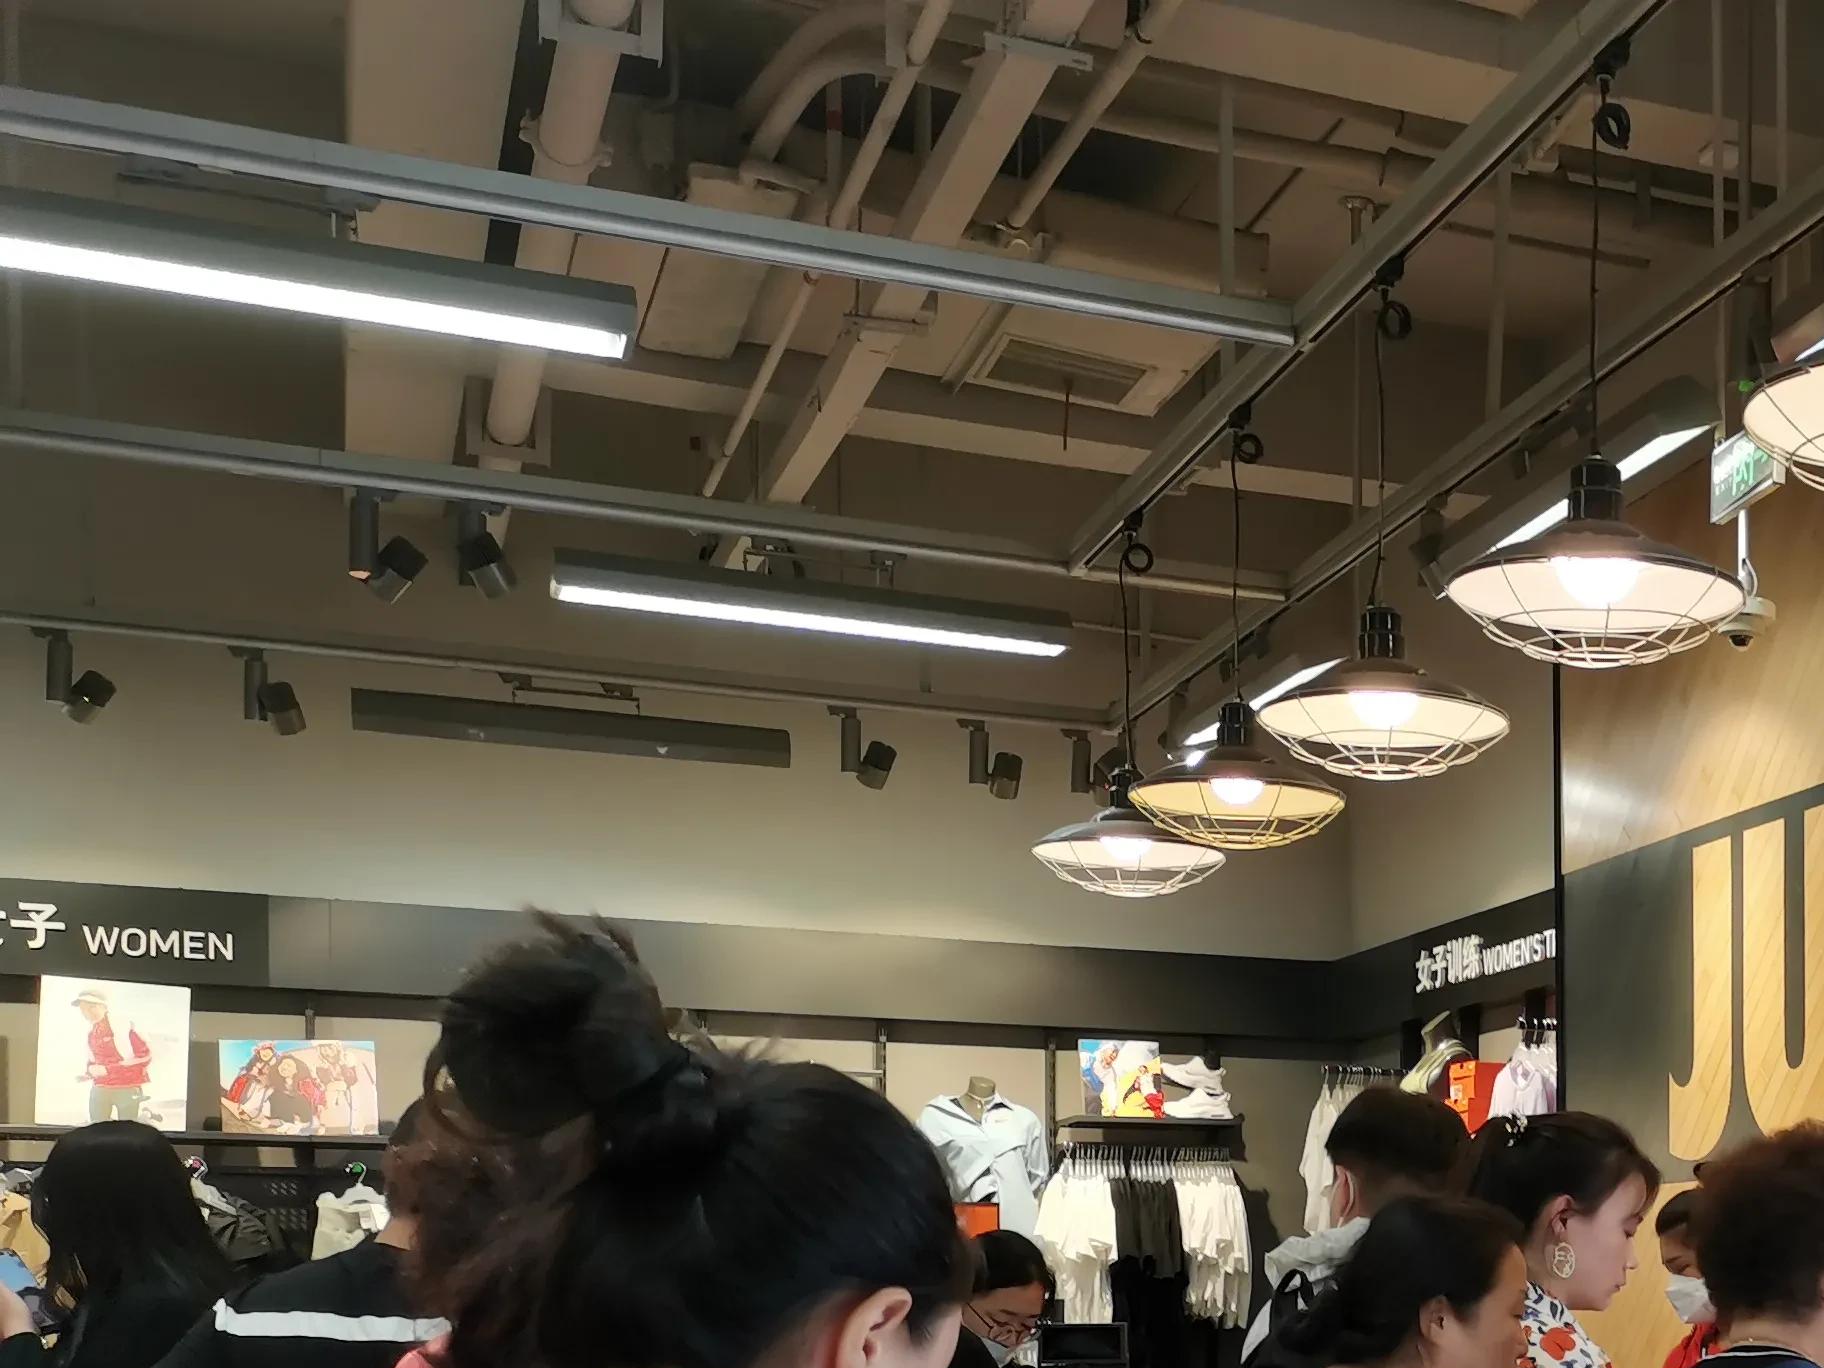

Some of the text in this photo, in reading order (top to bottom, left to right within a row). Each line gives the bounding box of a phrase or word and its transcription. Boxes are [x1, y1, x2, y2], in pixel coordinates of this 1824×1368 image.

[0, 900, 234, 961] 子 WOMEN
[1416, 934, 1483, 993] 女子训练
